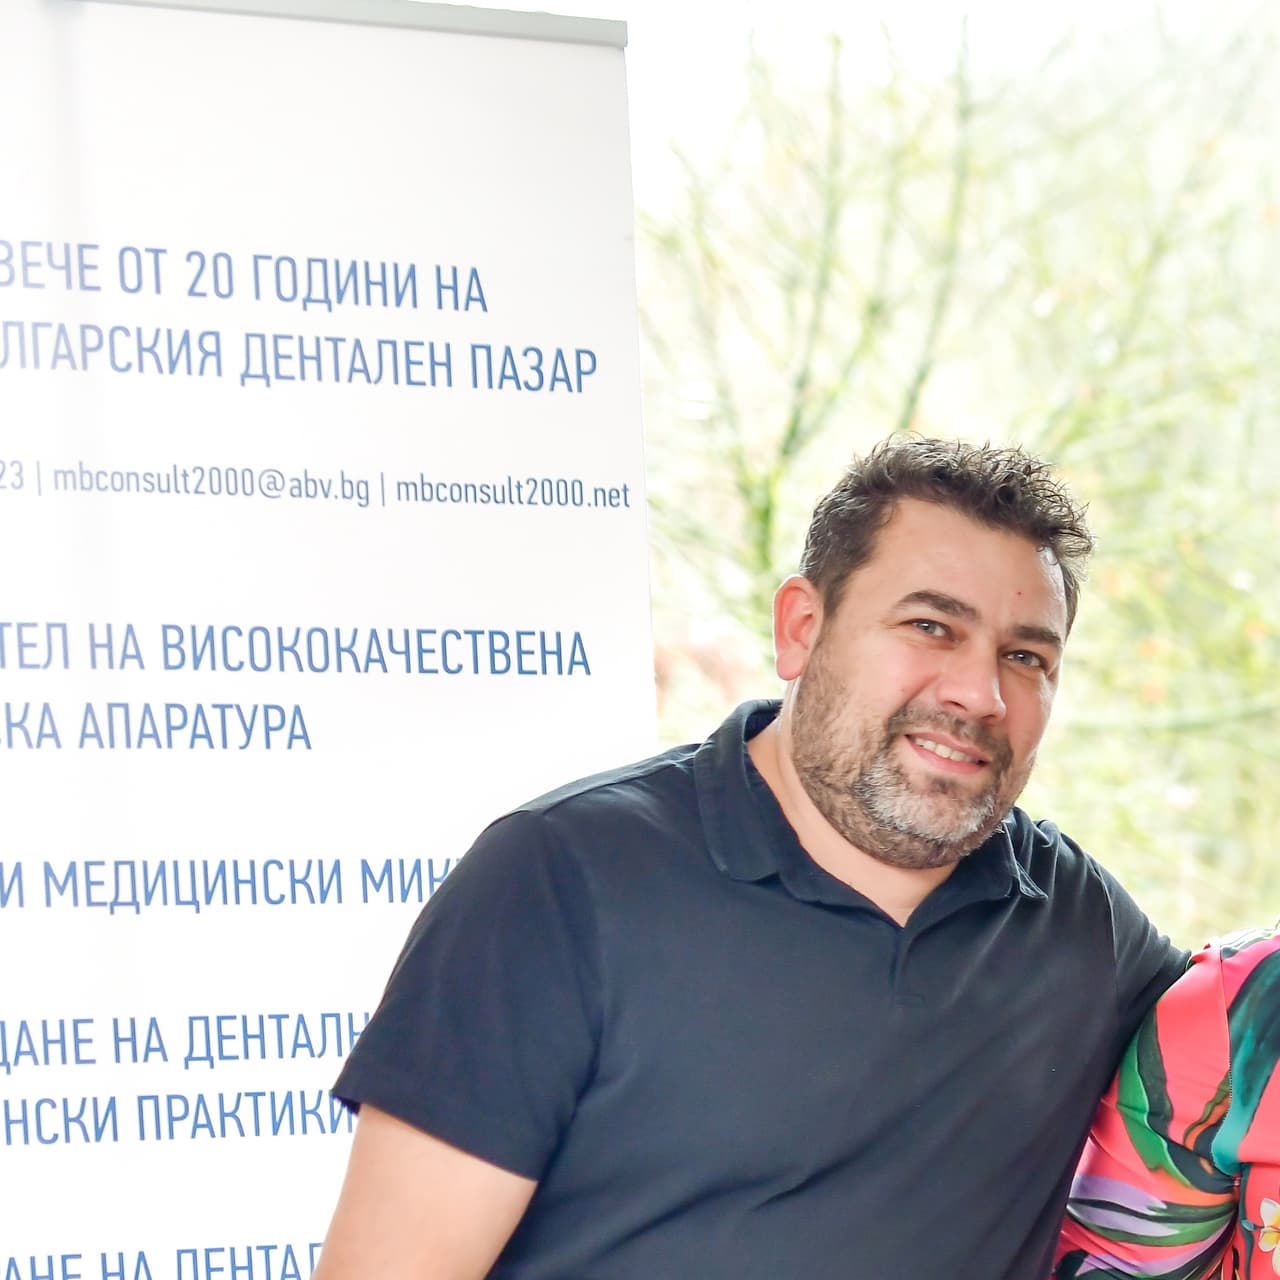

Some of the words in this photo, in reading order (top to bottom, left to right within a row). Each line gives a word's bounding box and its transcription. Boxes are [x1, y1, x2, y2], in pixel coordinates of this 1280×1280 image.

[118, 246, 167, 295] ОТ
[185, 250, 235, 298] 20
[252, 255, 419, 312] ГОДИНИ
[435, 264, 488, 312] НА
[0, 320, 224, 377] ЛГАРСКИЯ
[240, 333, 454, 388] ДЕНТАЛЕН
[470, 344, 598, 393] ПАЗАР
[53, 462, 370, 507] mbconsult2000@abv.bg
[396, 476, 630, 508] mbconsult2000.net
[88, 622, 145, 671] НА
[161, 624, 592, 676] ВИСОКОКАЧЕСТВЕНА
[0, 701, 62, 749] КА
[78, 702, 312, 749] АПАРАТУРА
[43, 859, 344, 915] МЕДИЦИНСКИ
[360, 858, 462, 904] МИК
[112, 1016, 169, 1064] НА
[3, 1098, 119, 1146] НСКИ
